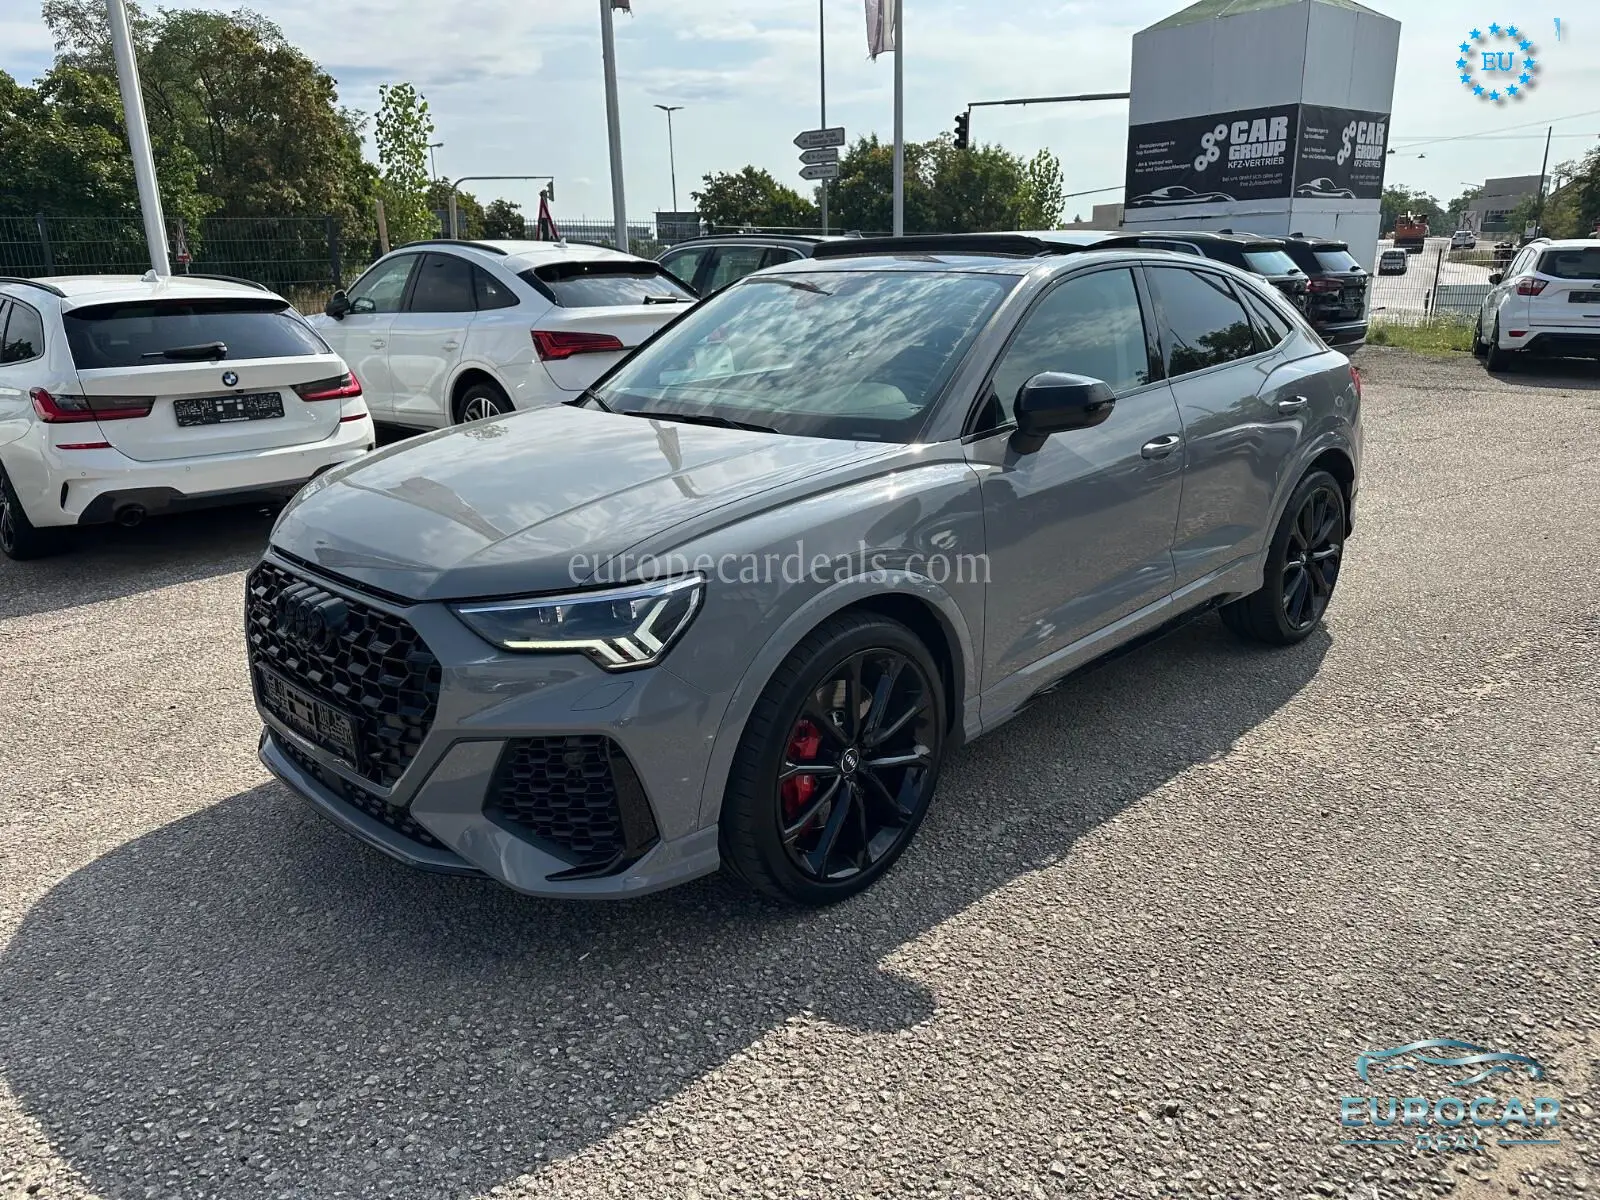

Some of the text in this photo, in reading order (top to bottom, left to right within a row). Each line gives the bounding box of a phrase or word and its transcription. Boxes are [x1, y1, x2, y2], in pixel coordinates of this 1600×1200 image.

[1230, 116, 1288, 144] CAR
[1357, 121, 1385, 145] CAR
[1229, 140, 1286, 160] GROUP
[1355, 145, 1383, 160] GROUP
[1228, 156, 1285, 169] KFZ-VERTRIEB
